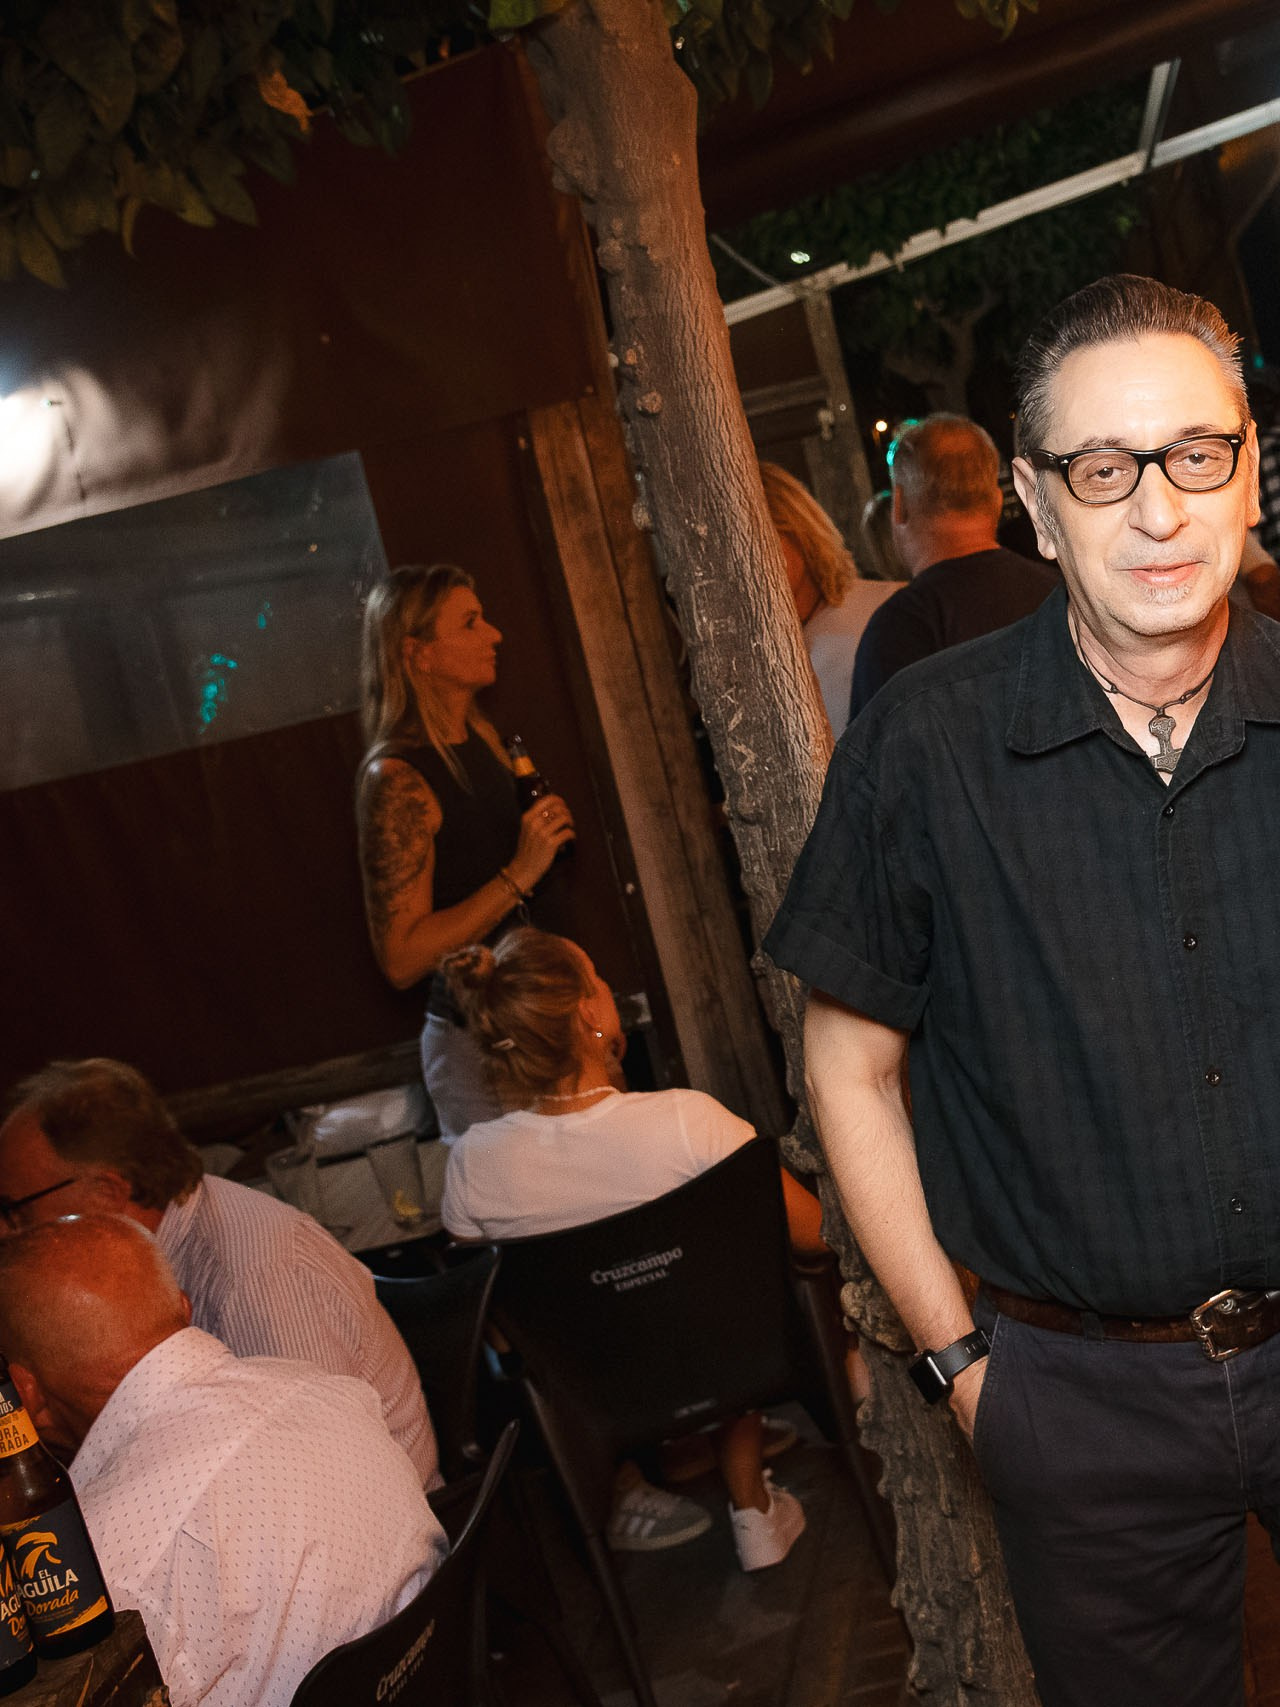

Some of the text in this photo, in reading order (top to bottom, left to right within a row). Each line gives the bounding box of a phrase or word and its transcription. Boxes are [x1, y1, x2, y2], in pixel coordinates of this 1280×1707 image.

[591, 1247, 683, 1285] Cruzcampo
[38, 1568, 51, 1580] EL
[24, 1589, 79, 1617] Dorada
